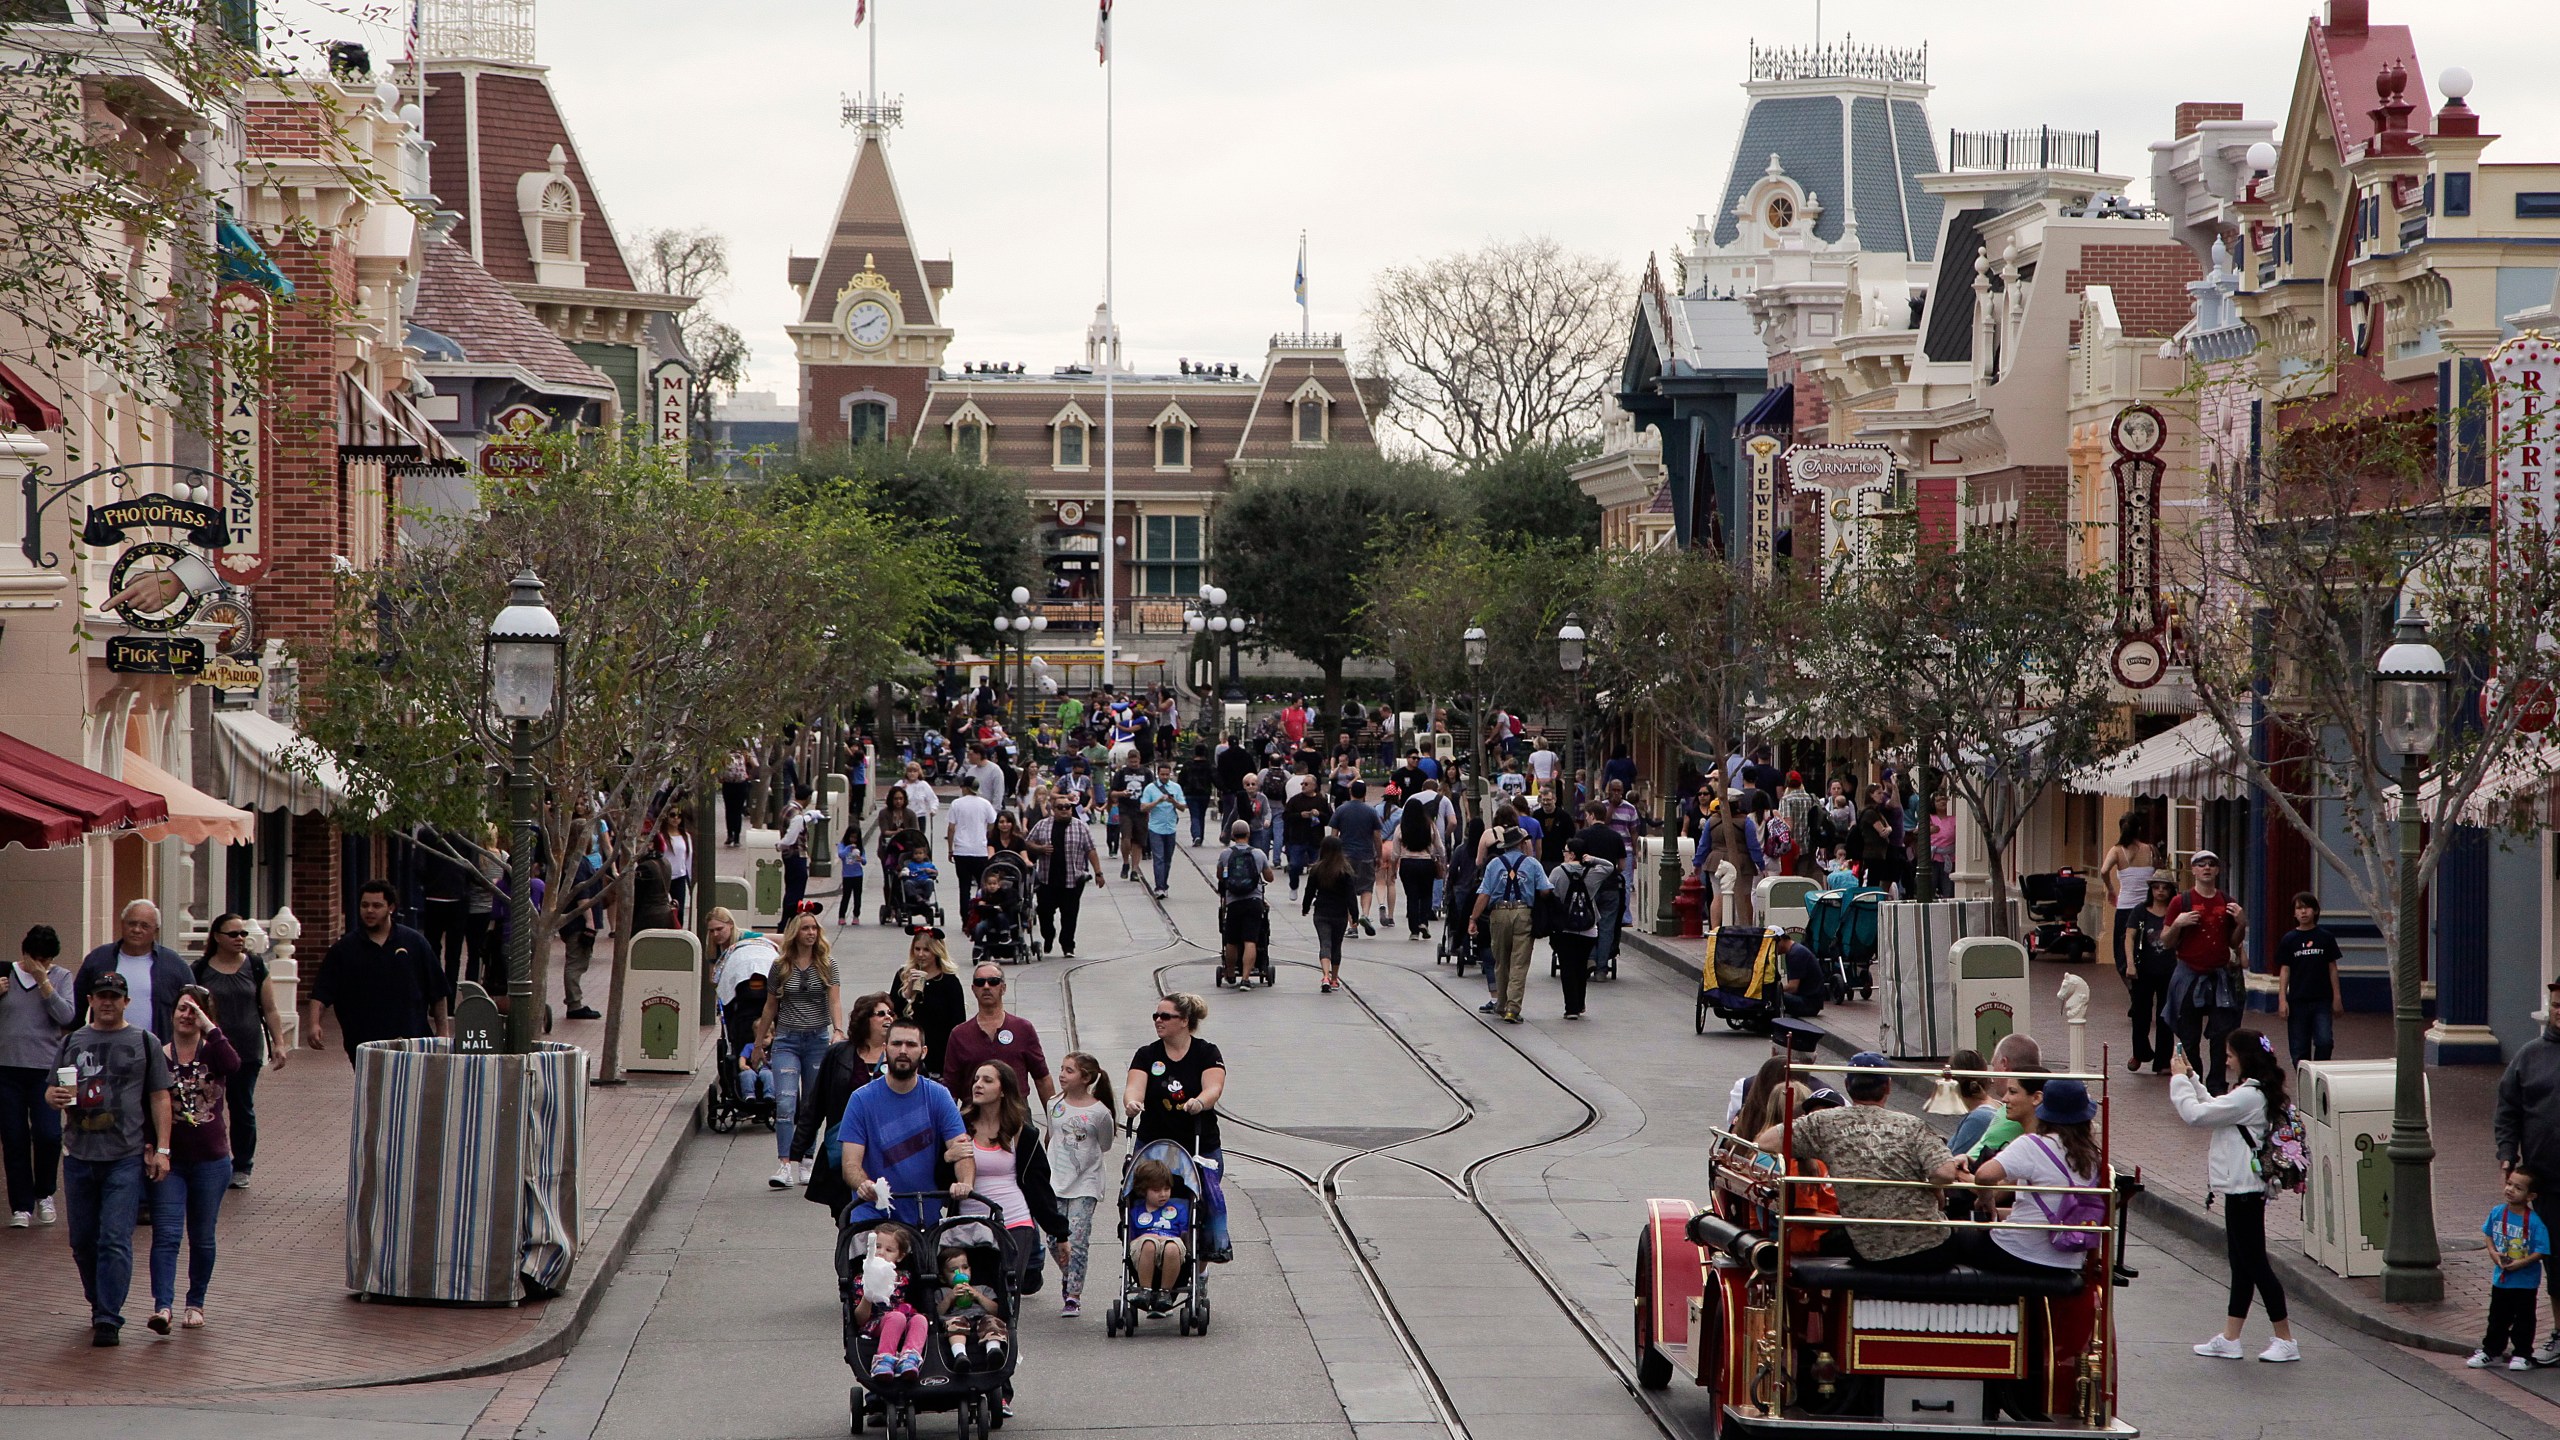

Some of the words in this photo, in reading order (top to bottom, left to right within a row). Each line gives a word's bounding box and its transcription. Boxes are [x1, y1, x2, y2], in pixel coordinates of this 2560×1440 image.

[1798, 458, 1884, 480] CARNATION
[2129, 470, 2147, 526] ICE
[2129, 532, 2148, 617] CREAM
[196, 667, 218, 681] ALM
[218, 666, 259, 683] PARLOR
[462, 1039, 493, 1050] MAIL
